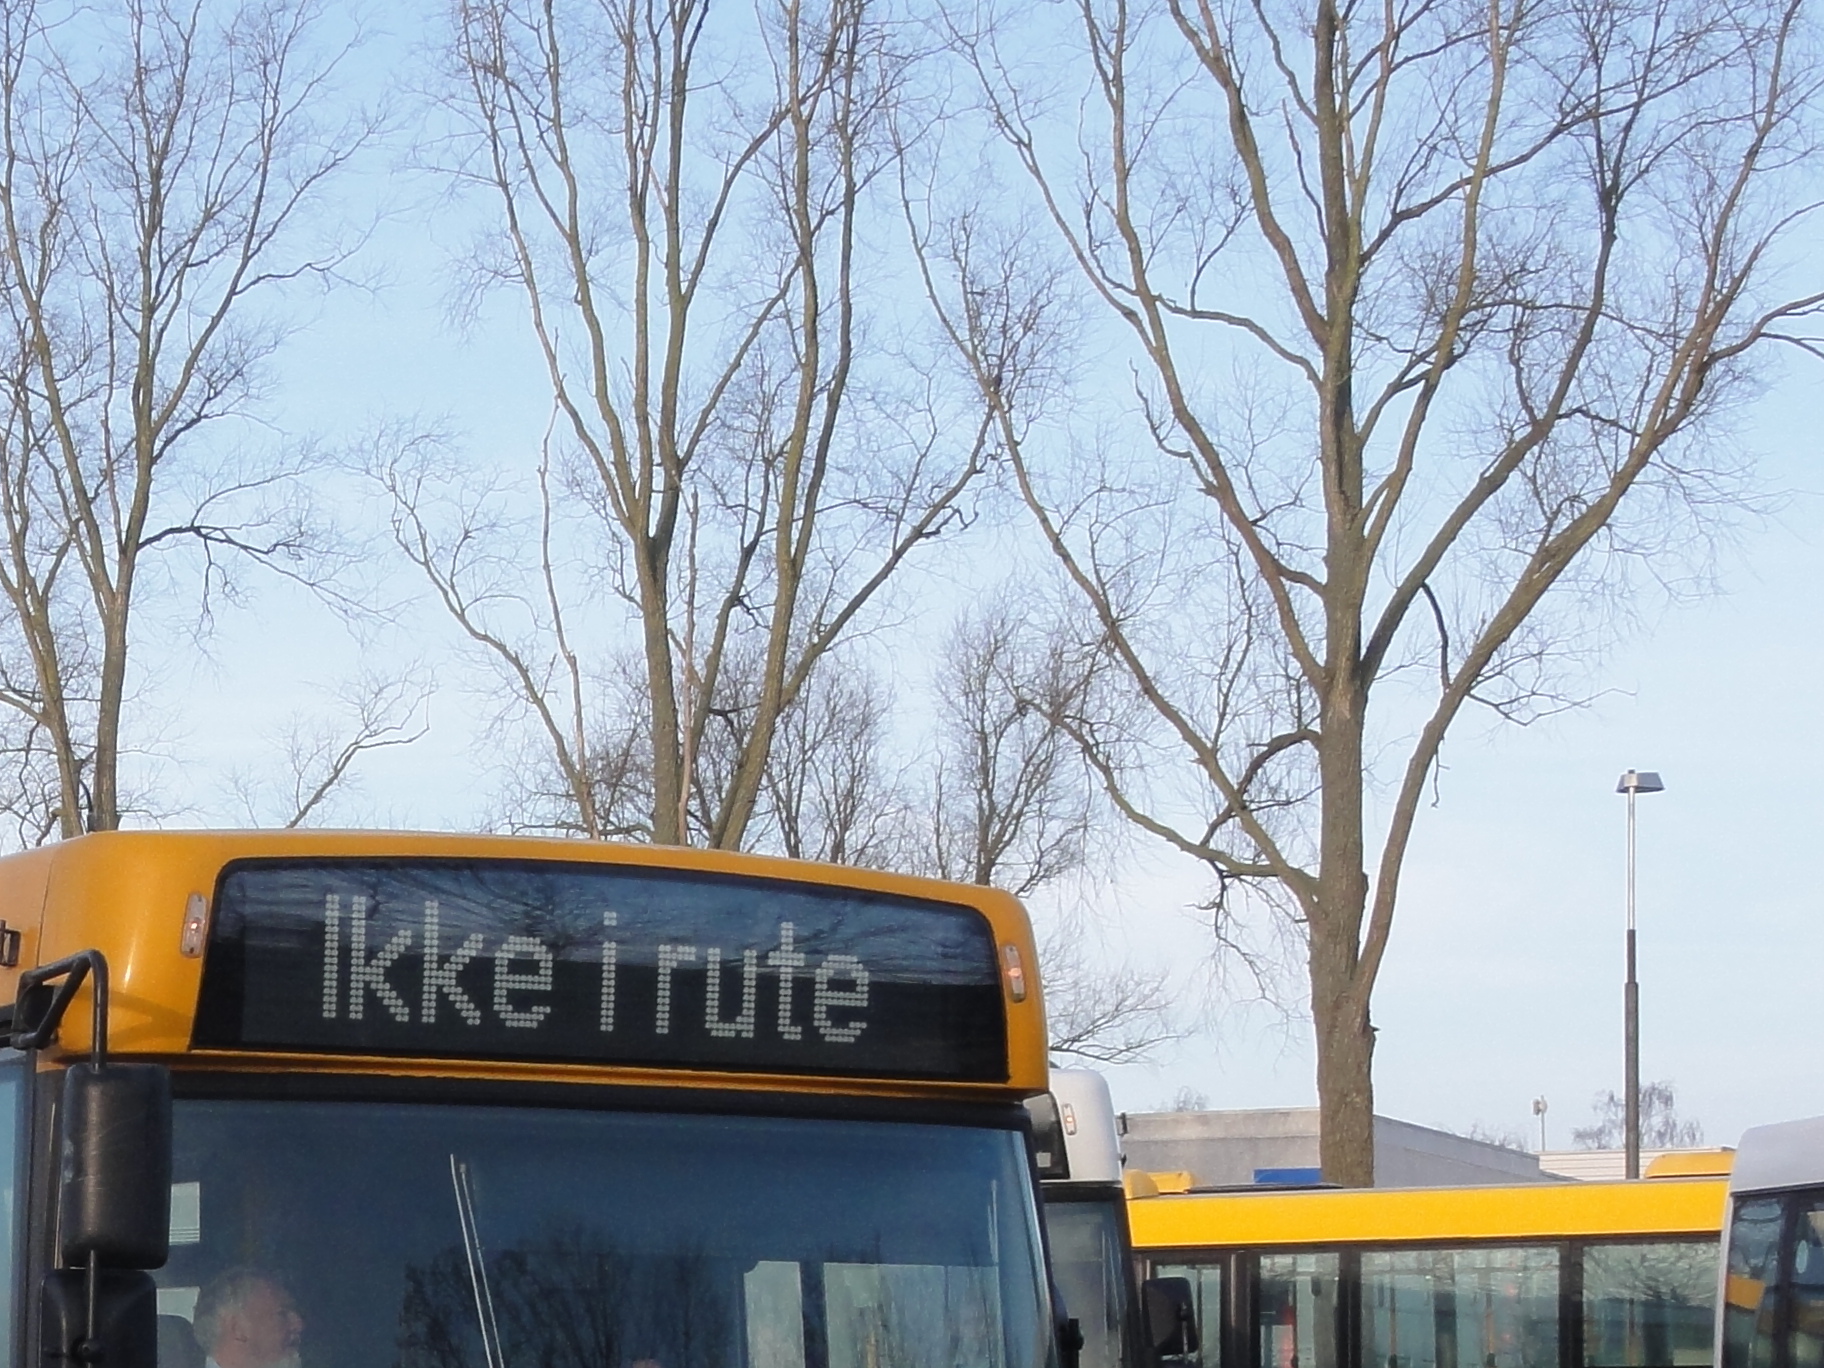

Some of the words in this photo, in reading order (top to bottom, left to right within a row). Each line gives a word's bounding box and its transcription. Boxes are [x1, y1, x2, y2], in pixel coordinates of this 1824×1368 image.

[321, 893, 553, 1029] Ikke
[600, 910, 618, 1033] i
[655, 920, 871, 1043] rute
